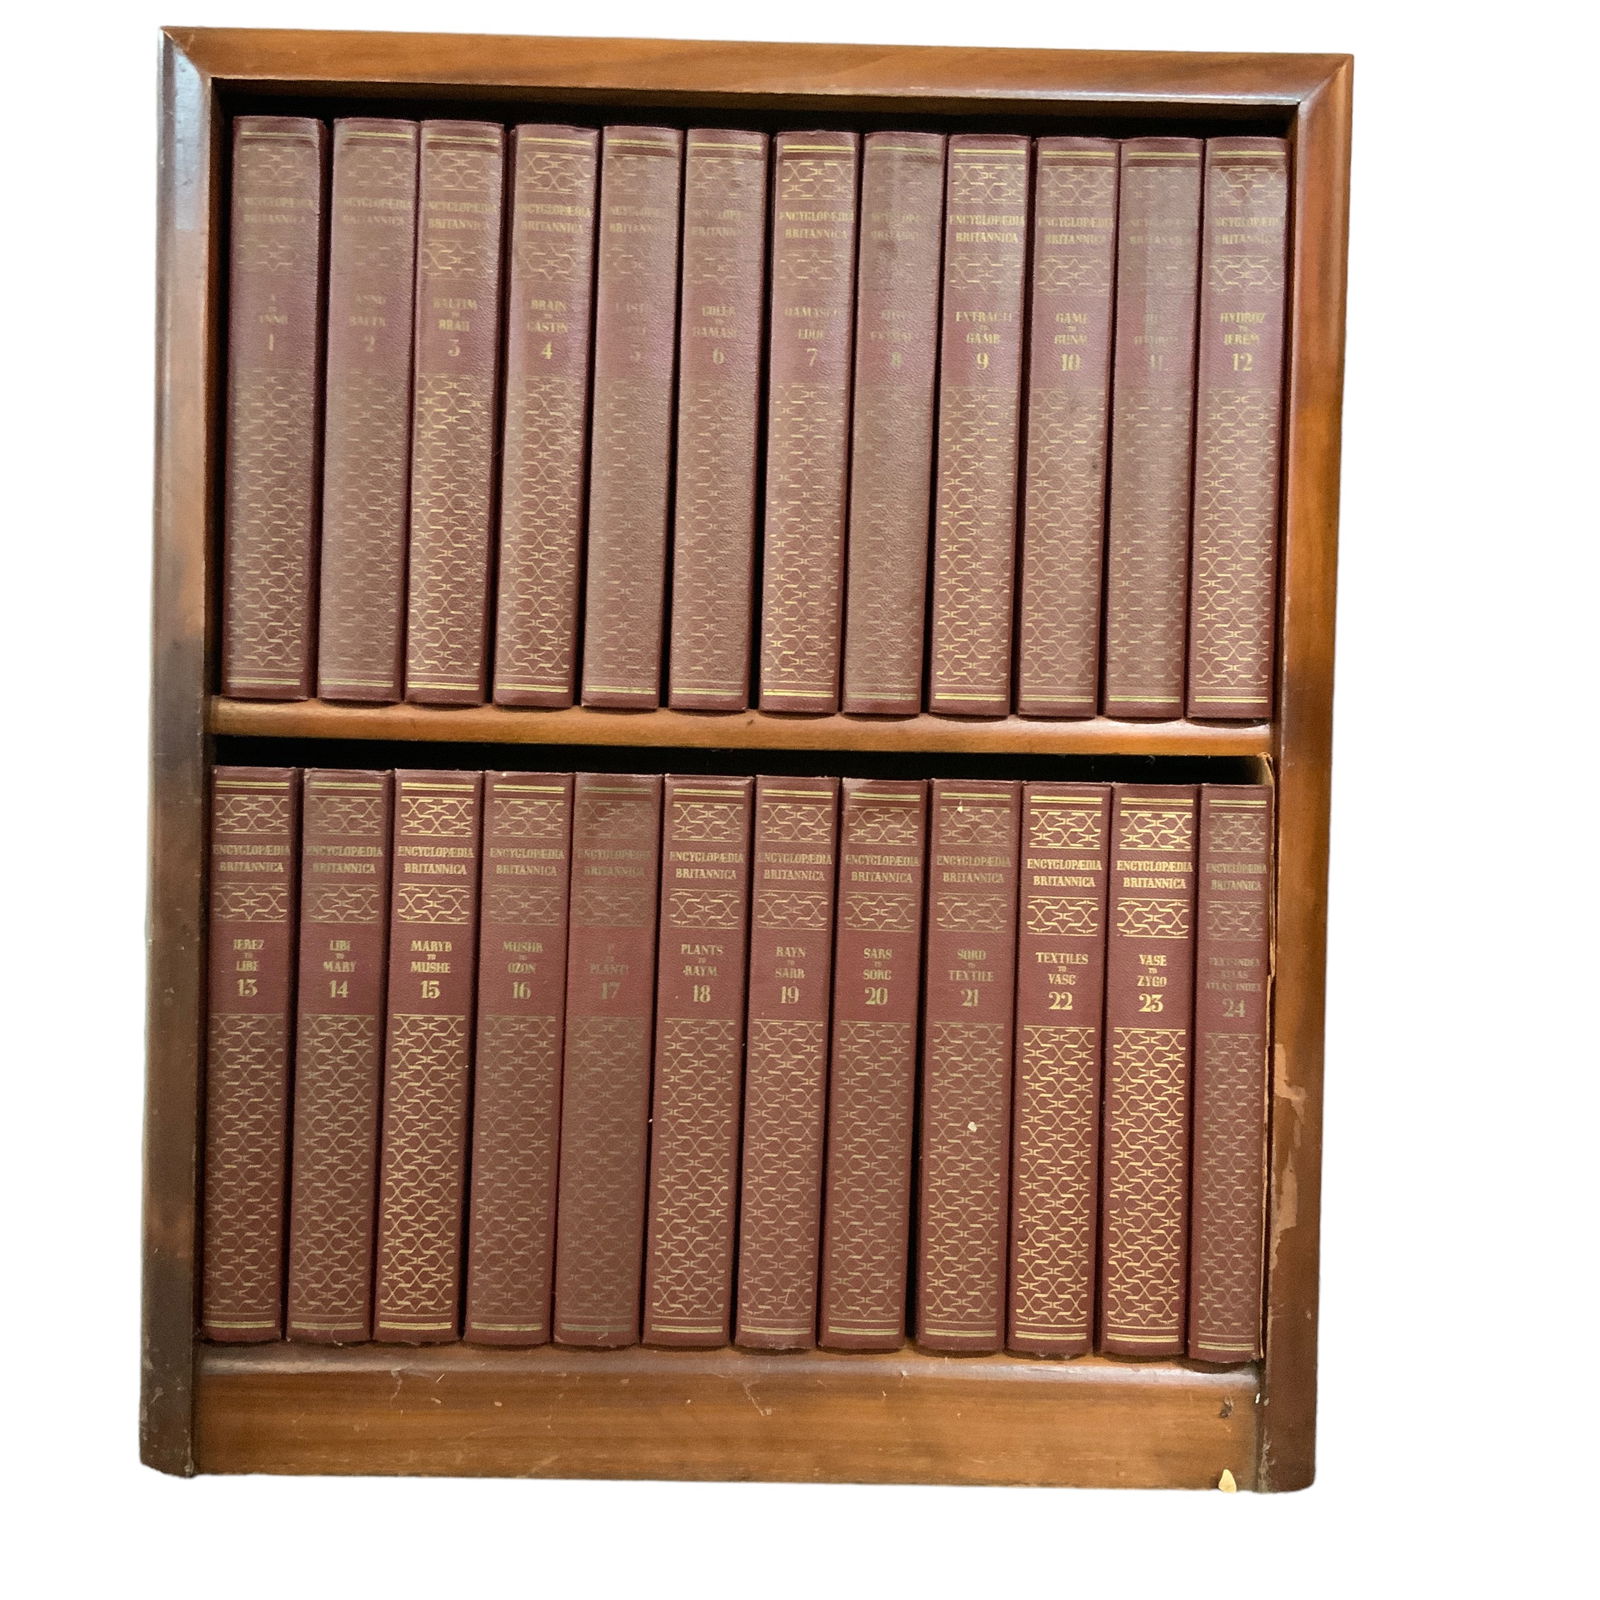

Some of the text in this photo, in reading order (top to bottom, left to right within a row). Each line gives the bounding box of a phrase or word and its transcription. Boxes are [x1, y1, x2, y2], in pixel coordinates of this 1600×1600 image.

[956, 233, 1018, 243] BRITANNICA
[268, 333, 274, 351] 1
[364, 336, 375, 352] 2
[448, 339, 460, 356] 3
[541, 342, 553, 359] 4
[713, 348, 724, 364] 6
[807, 348, 818, 367] 7
[976, 353, 989, 369] 9
[1060, 354, 1081, 371] 10
[1232, 353, 1253, 371] 12
[397, 846, 474, 858] ENCYCLOPÆDIA
[490, 848, 565, 860] ENCYCLOPÆDIA
[669, 851, 744, 863] ENCYCLOPÆDIA
[219, 862, 284, 872] BRITANNICA
[846, 855, 920, 867] ENCYCLOPÆDIA
[937, 856, 1011, 867] ENCYCLOPÆDIA
[1027, 859, 1102, 871] ENCYCLOPÆDIA
[1116, 860, 1192, 872] ENCYCLOPÆDIA
[313, 863, 376, 874] BRITANNICA
[404, 863, 467, 875] BRITANNICA
[496, 865, 557, 876] BRITANNICA
[676, 868, 737, 879] BRITANNICA
[764, 870, 825, 881] BRITANNICA
[851, 872, 913, 883] BRITANNICA
[943, 872, 1005, 883] BRITANNICA
[1033, 876, 1096, 887] BRITANNICA
[1123, 878, 1187, 889] BRITANNICA
[1212, 880, 1261, 891] BRITANNICA
[410, 940, 452, 951] MARYB
[681, 944, 723, 955] PLANTS
[864, 948, 892, 960] SARS
[1036, 952, 1089, 965] TEXTILES
[1139, 955, 1167, 967] VASE
[410, 962, 451, 973] MUSHE
[508, 963, 536, 974] OZON
[948, 970, 994, 982] TEXTILE
[1137, 976, 1167, 987] ZYGO
[237, 979, 258, 997] 13
[330, 980, 348, 998] 14
[420, 981, 440, 999] 15
[512, 981, 531, 999] 16
[601, 982, 621, 1000] 17
[693, 985, 711, 1003] 18
[780, 986, 800, 1004] 19
[865, 987, 888, 1006] 20
[960, 989, 979, 1007] 21
[1049, 992, 1073, 1011] 22
[1137, 994, 1164, 1013] 23
[1223, 999, 1246, 1018] 24
